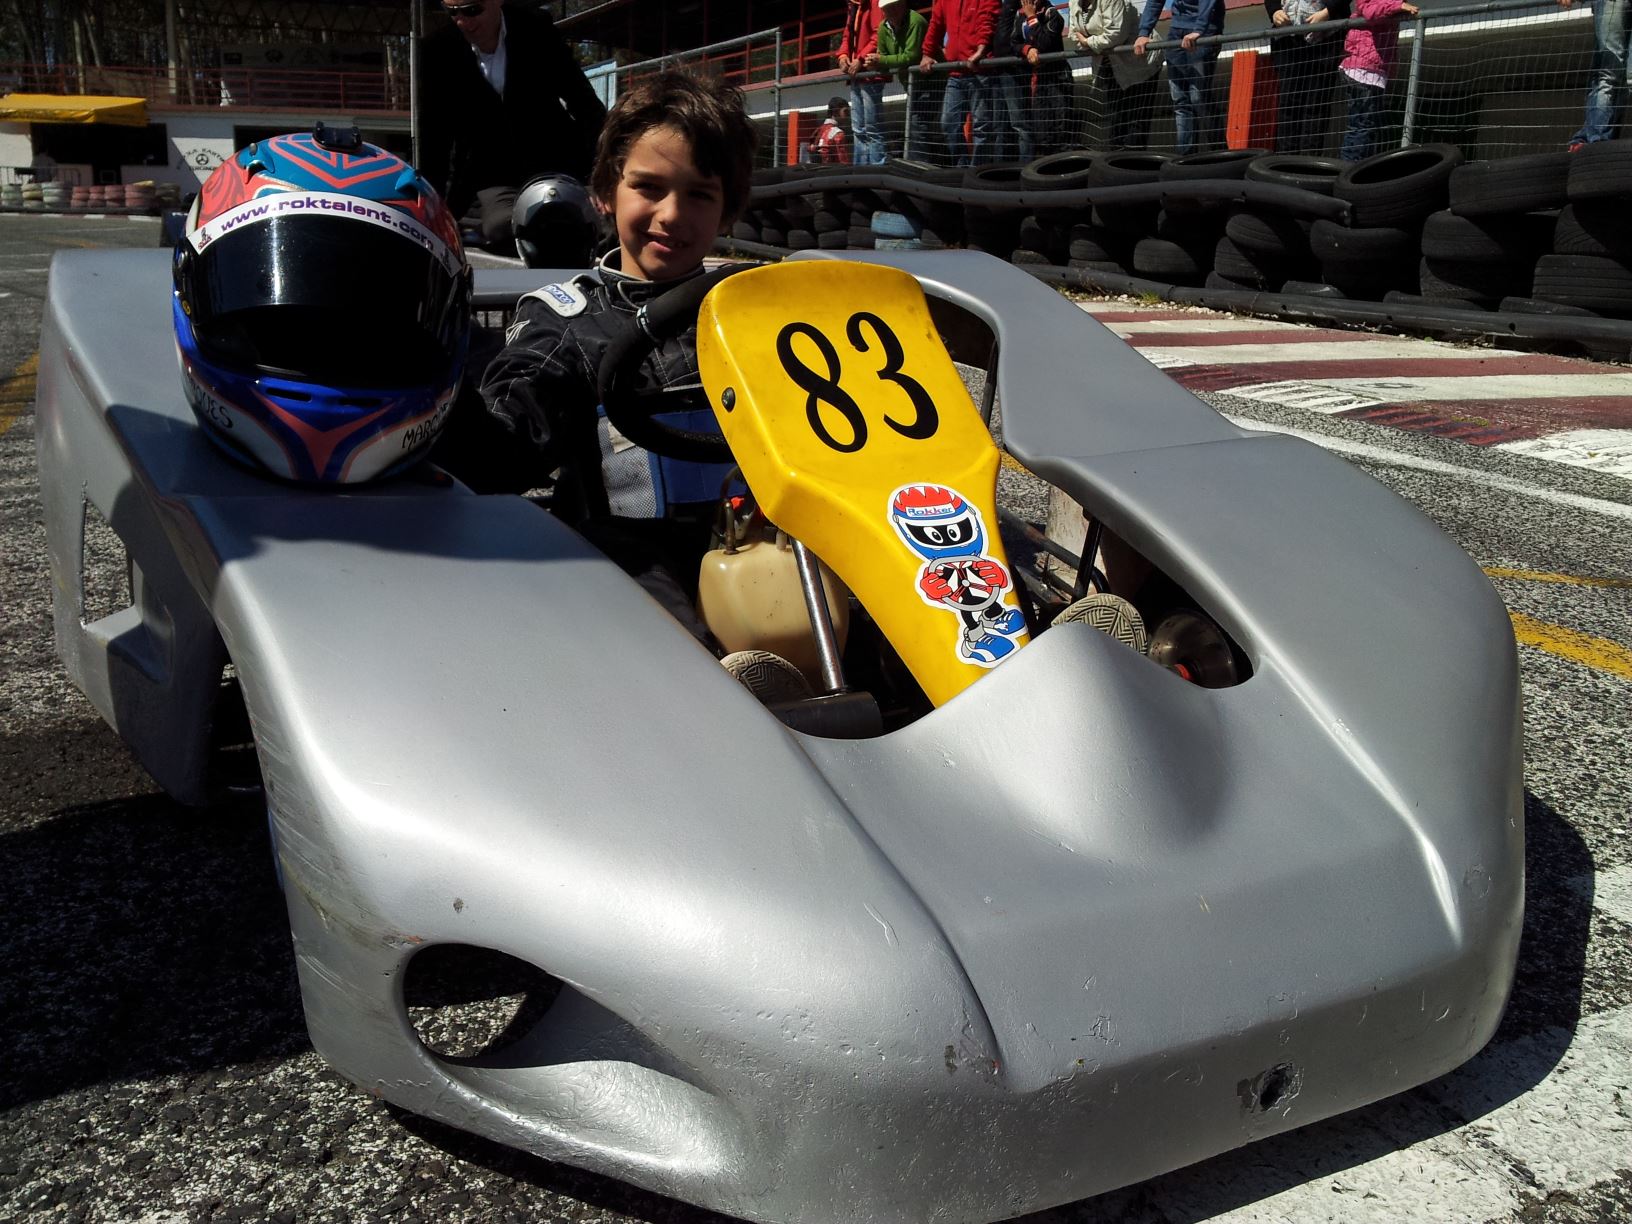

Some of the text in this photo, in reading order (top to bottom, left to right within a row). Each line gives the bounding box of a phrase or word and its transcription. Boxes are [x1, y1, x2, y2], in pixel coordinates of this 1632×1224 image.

[221, 197, 434, 251] www.roktalent.com
[776, 312, 939, 453] 83
[907, 506, 953, 517] Rokker
